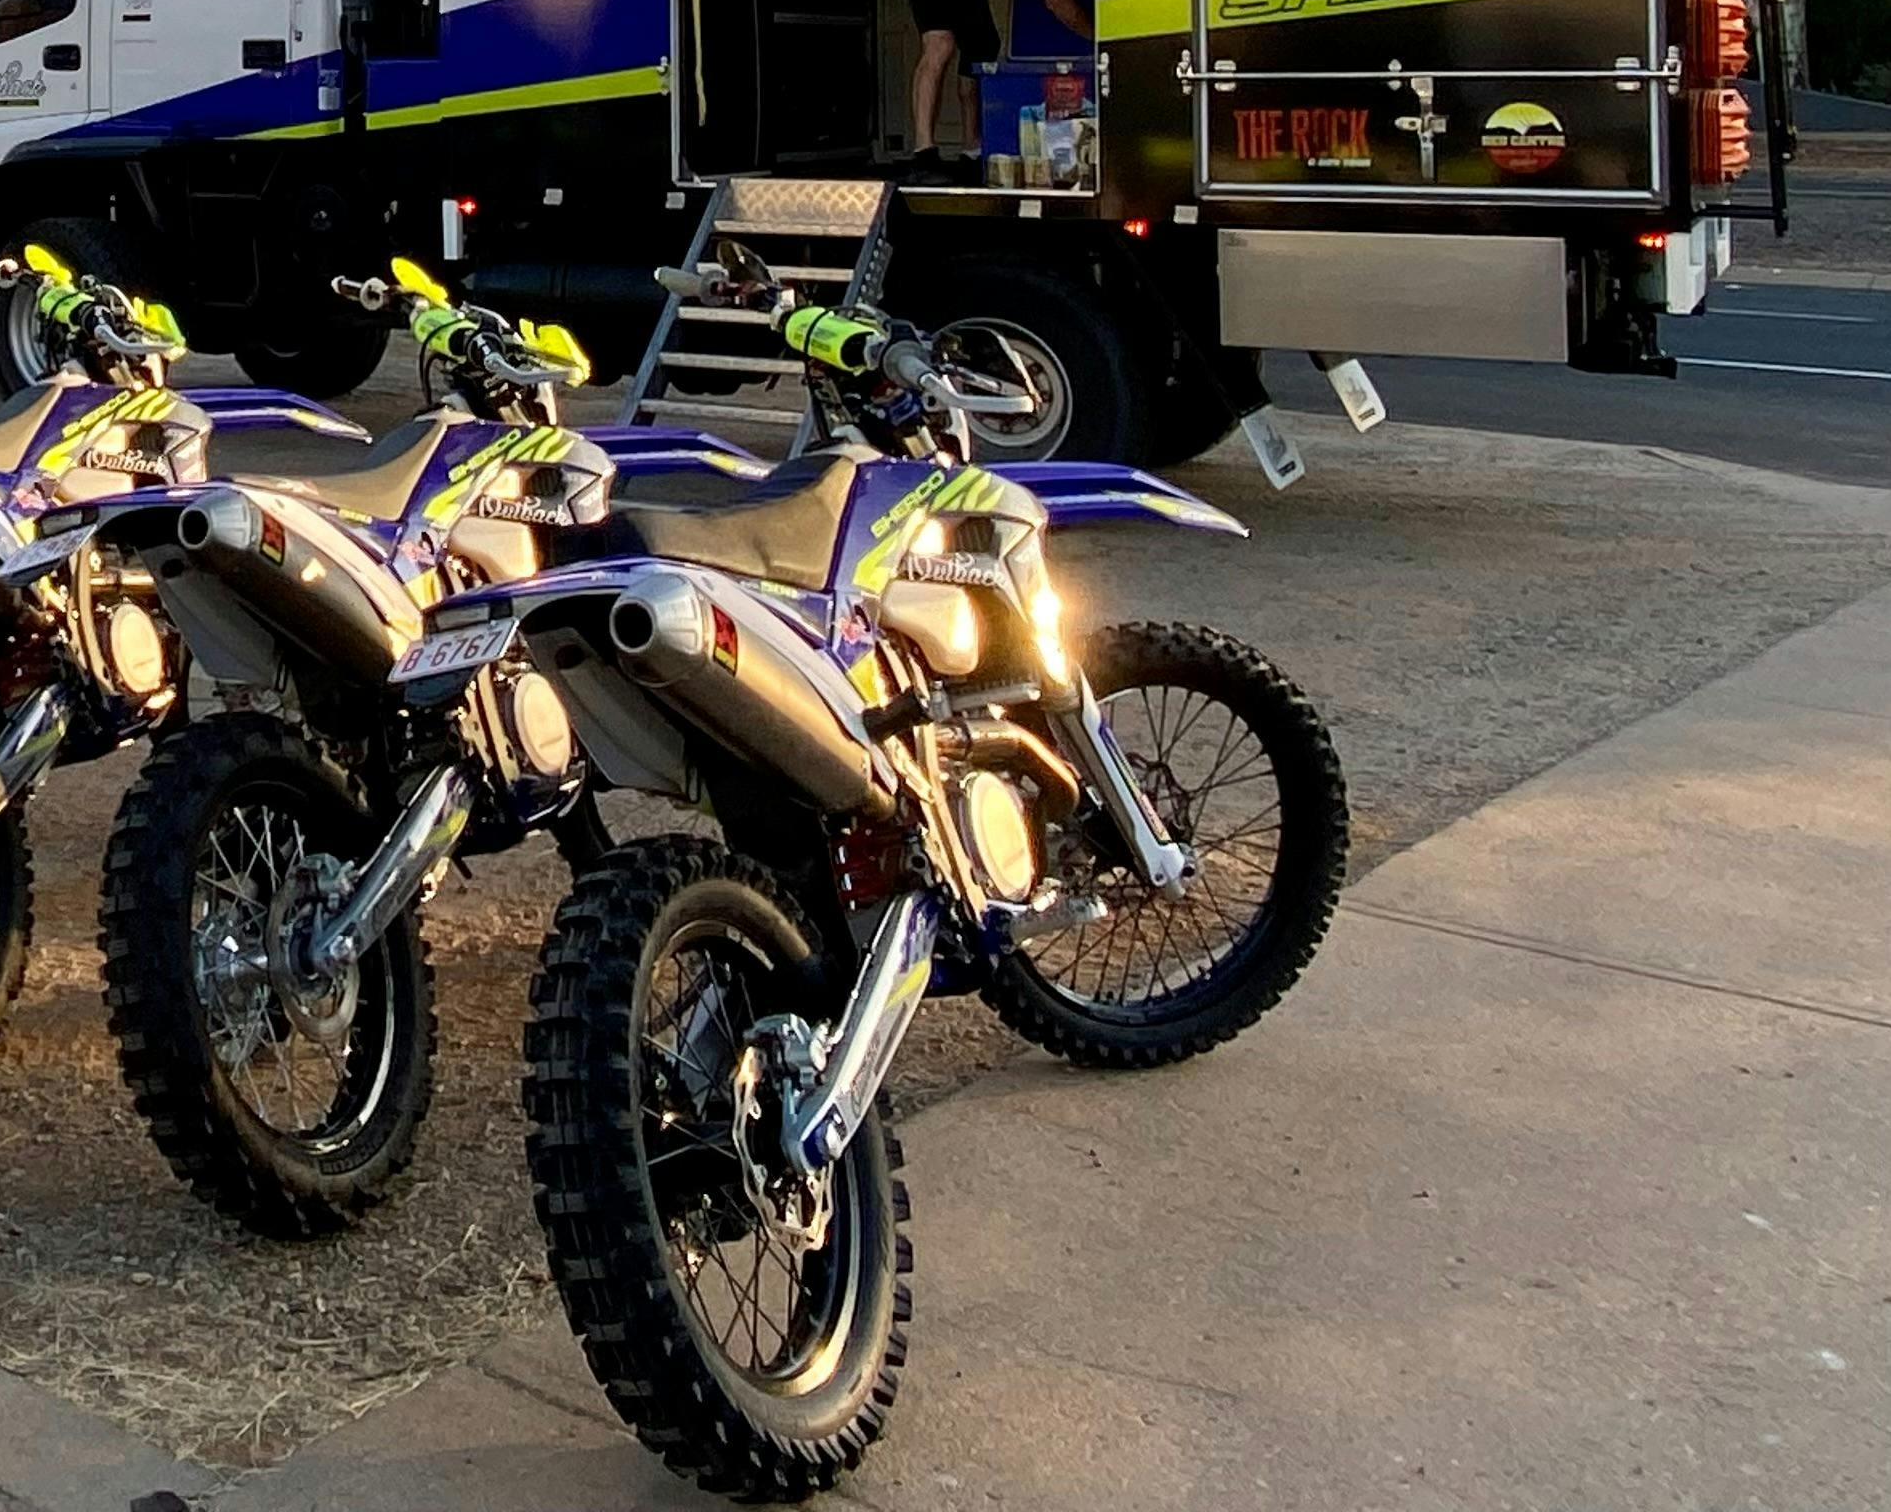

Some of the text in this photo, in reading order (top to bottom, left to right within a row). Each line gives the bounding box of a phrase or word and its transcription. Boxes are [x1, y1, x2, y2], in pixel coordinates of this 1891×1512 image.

[1233, 108, 1371, 159] THE ROCK
[430, 631, 503, 666] 6767
